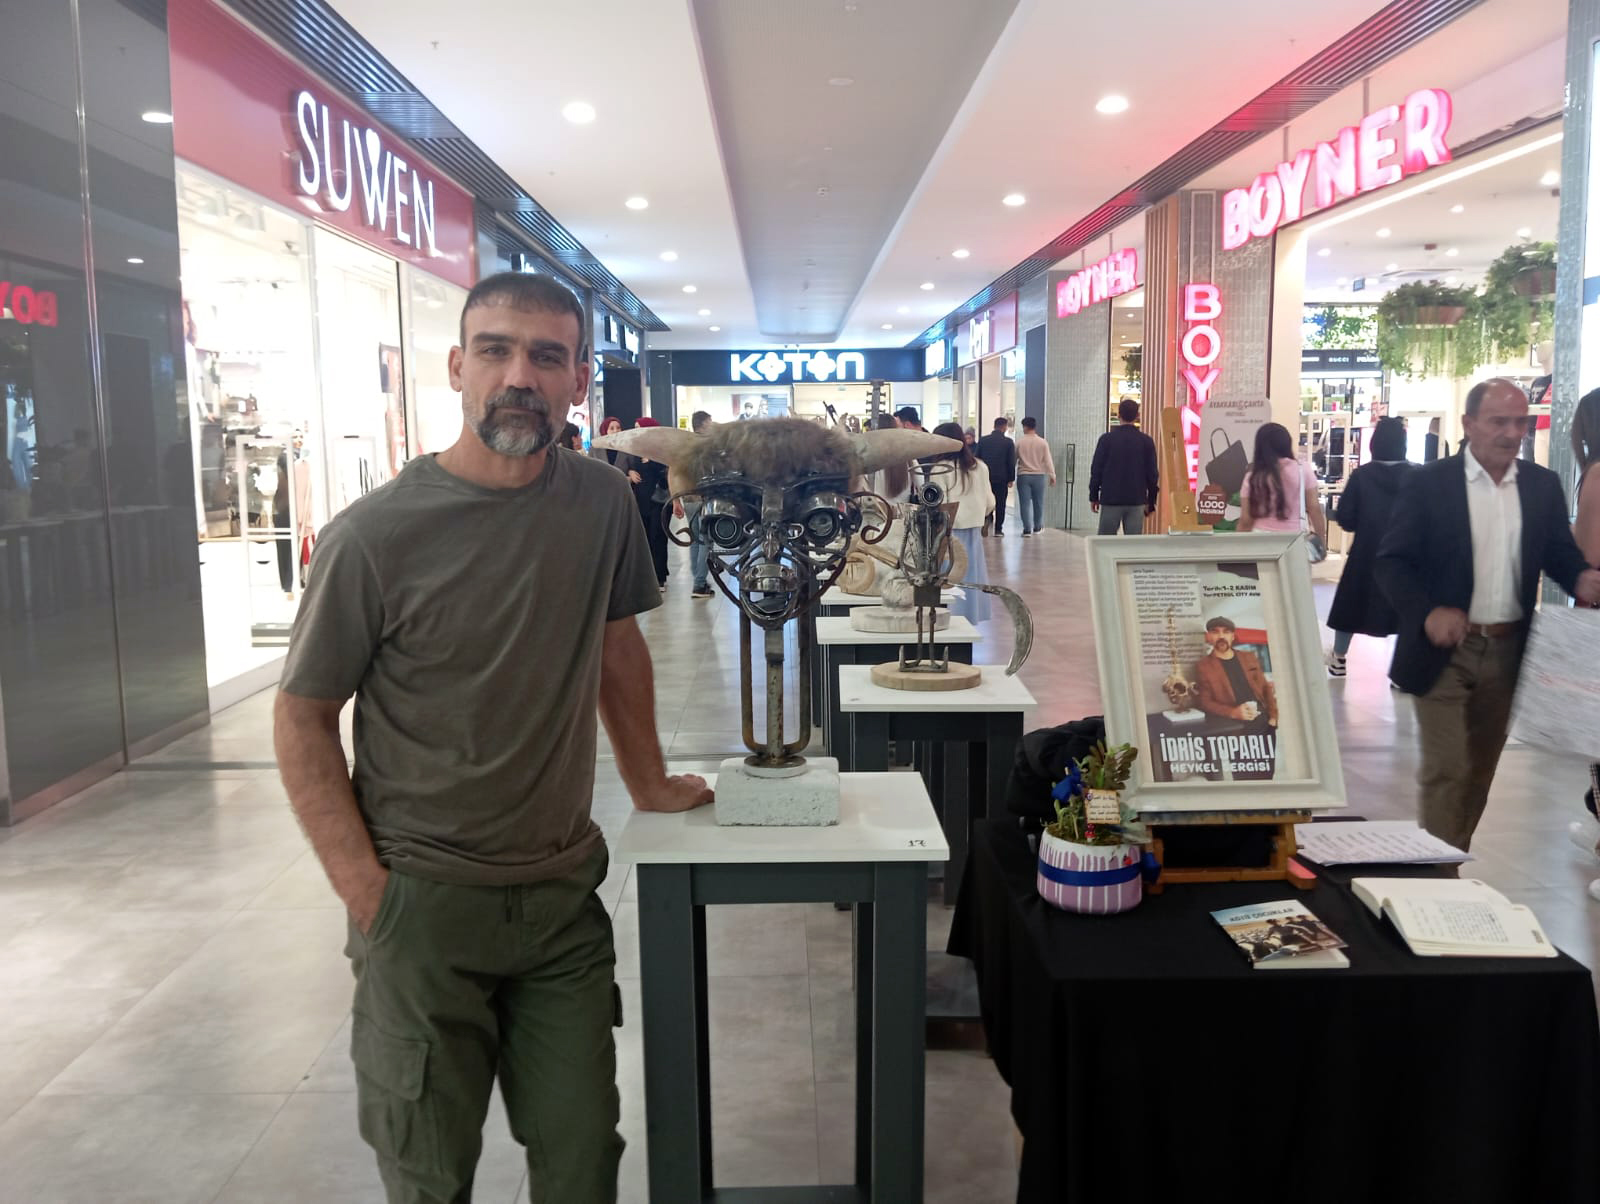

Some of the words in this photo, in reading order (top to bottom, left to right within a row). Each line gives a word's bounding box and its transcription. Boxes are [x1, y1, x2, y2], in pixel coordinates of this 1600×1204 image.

[298, 90, 441, 258] SUWEN
[1222, 88, 1453, 250] BOYNER
[1056, 247, 1137, 319] BOYNER
[730, 350, 865, 382] KOTON
[1182, 284, 1222, 491] BOYNE
[1160, 732, 1206, 762] İDRİS
[1206, 734, 1275, 760] TOPARLI
[1170, 763, 1219, 773] HEYKEL
